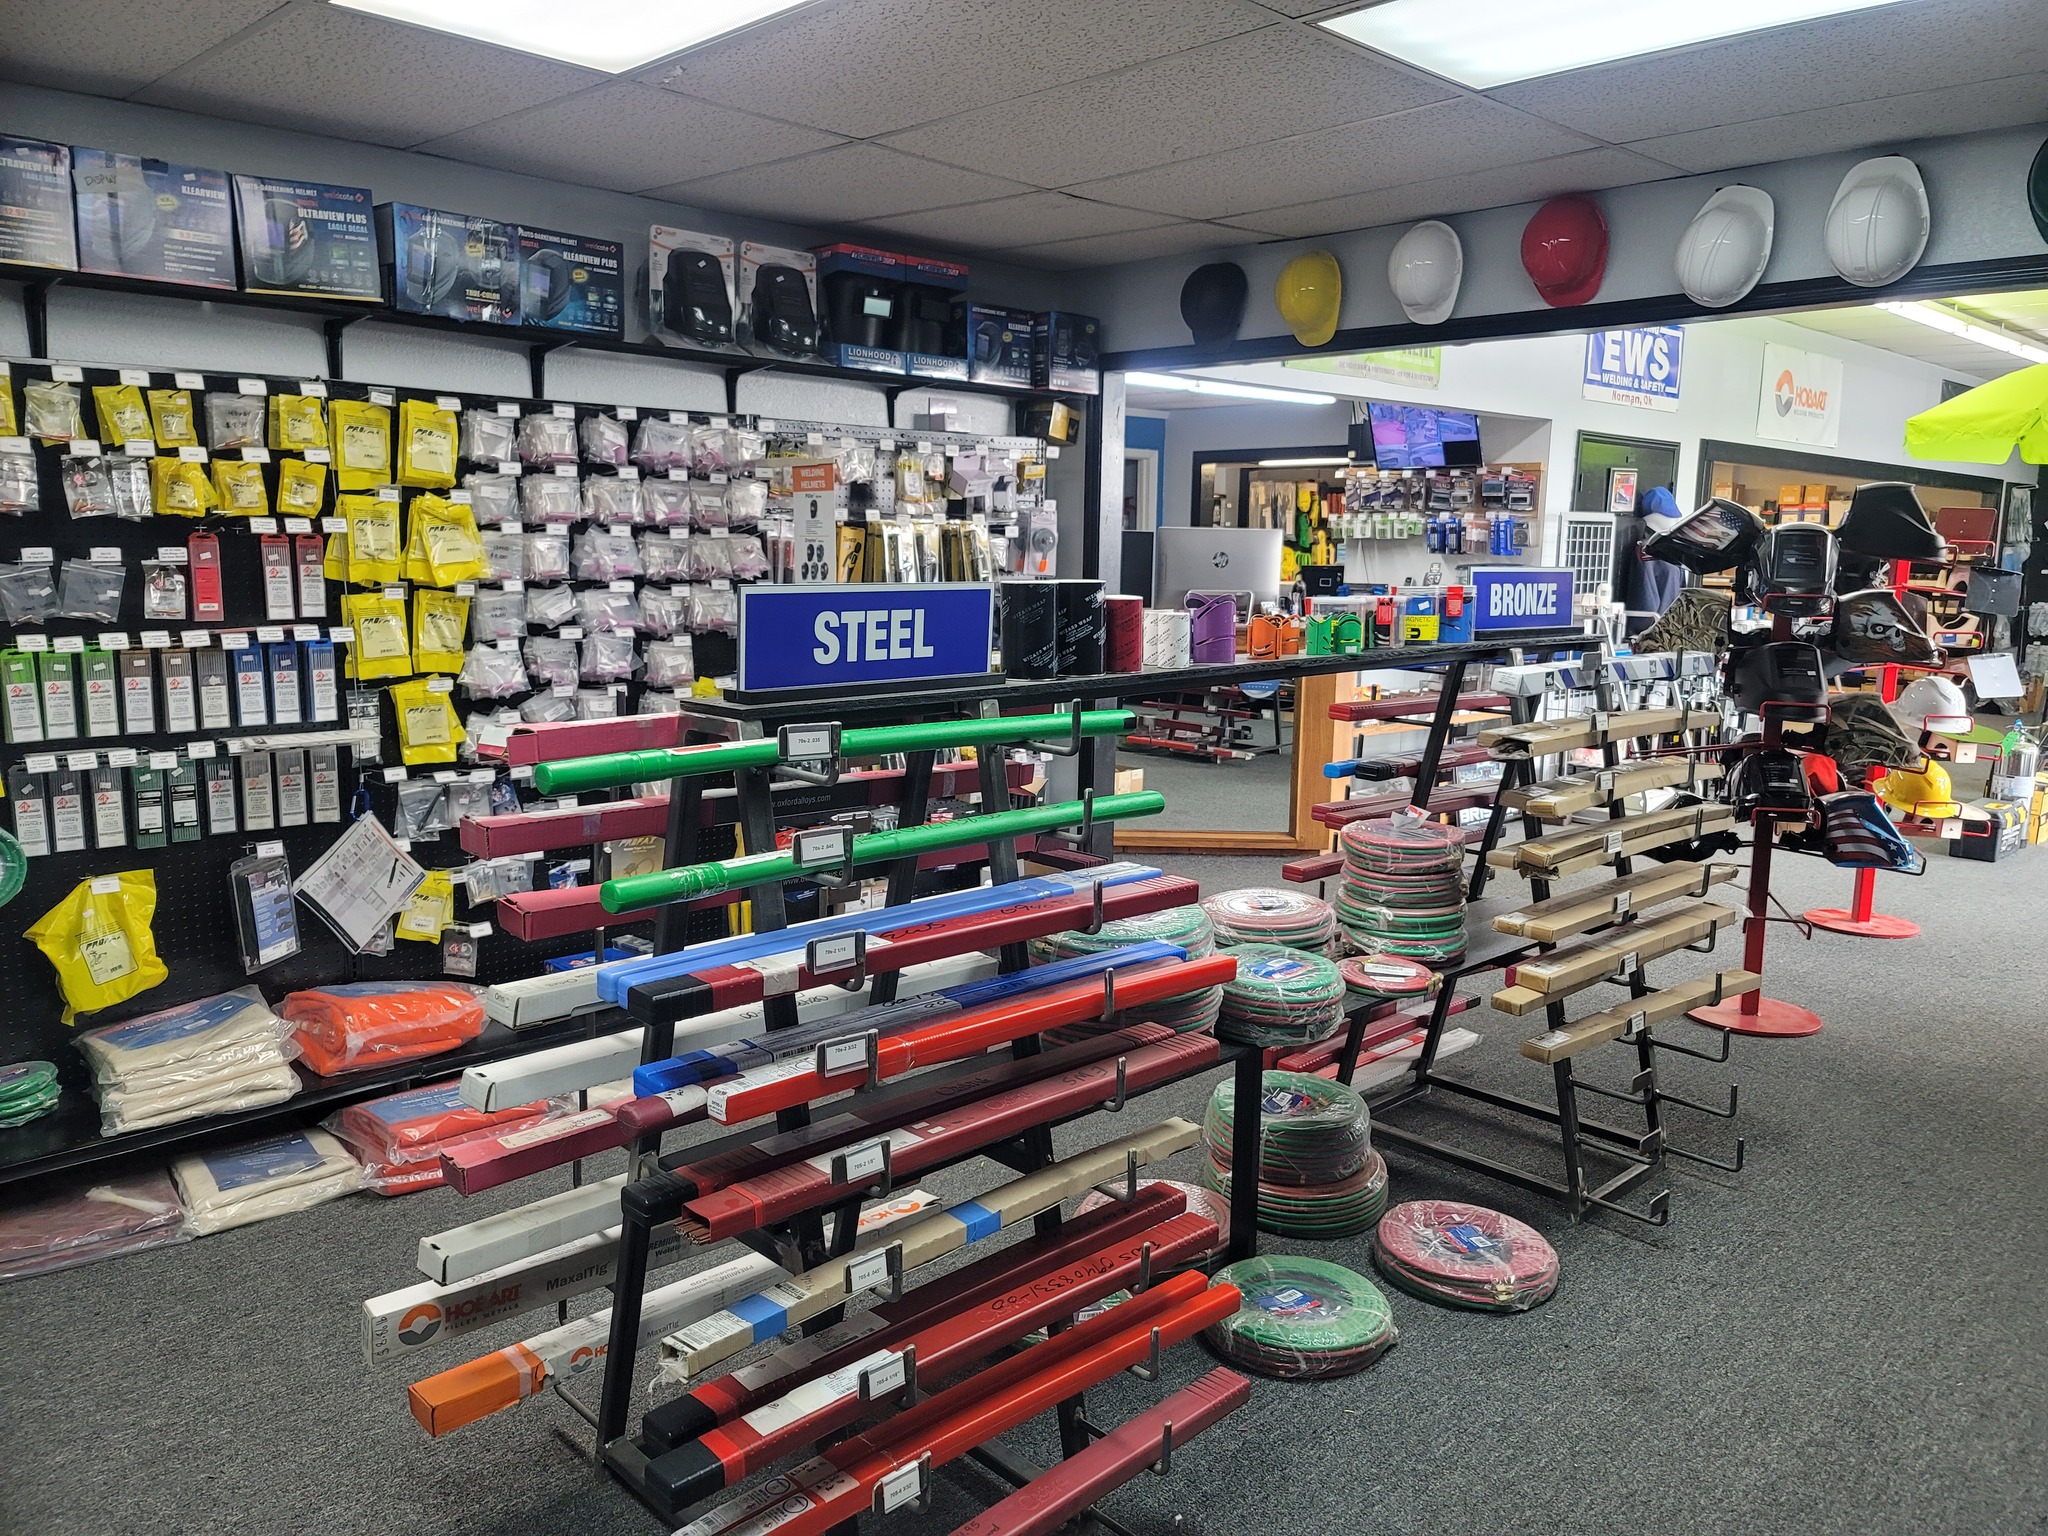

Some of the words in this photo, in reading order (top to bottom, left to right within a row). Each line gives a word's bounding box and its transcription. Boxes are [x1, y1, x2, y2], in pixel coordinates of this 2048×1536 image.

[181, 185, 226, 200] KLEARVIEW
[295, 187, 318, 197] HELMET
[297, 207, 345, 223] ULTRAVIEW
[346, 213, 368, 225] PLUS
[327, 222, 347, 233] EAGLE
[348, 225, 369, 234] DECAL
[563, 251, 601, 266] KLEARVIEW
[601, 258, 618, 269] PLUS
[848, 347, 891, 361] LIONHOOD
[913, 355, 954, 368] LIONHOOD
[1602, 331, 1670, 381] EWS
[1602, 372, 1632, 389] WELDING
[1633, 379, 1640, 389] &
[1640, 380, 1667, 394] SAFETY
[1611, 389, 1642, 407] Norman,
[1795, 385, 1828, 412] HOBART
[800, 467, 825, 478] WELDING
[800, 480, 826, 489] HELMETS
[1489, 582, 1558, 617] BRONZE
[1079, 614, 1093, 627] WRAP
[813, 608, 934, 665] STEEL
[618, 836, 657, 848] PROFAX
[835, 1046, 847, 1054] 70s-2
[1062, 1065, 1109, 1087] EWS
[854, 1162, 867, 1170] 70S-2
[648, 1235, 681, 1252] REMIUM
[546, 1262, 608, 1292] MaxalTig
[858, 1273, 871, 1281] 70S-6
[870, 1267, 882, 1277] .045"
[444, 1283, 523, 1323] HOBART
[444, 1317, 478, 1333] FILLER
[485, 1303, 520, 1319] METALS
[646, 1318, 681, 1340] MaxalTig
[876, 1377, 889, 1386] 70S-6
[889, 1371, 901, 1381] 1/16"
[890, 1490, 903, 1499] 70S-6
